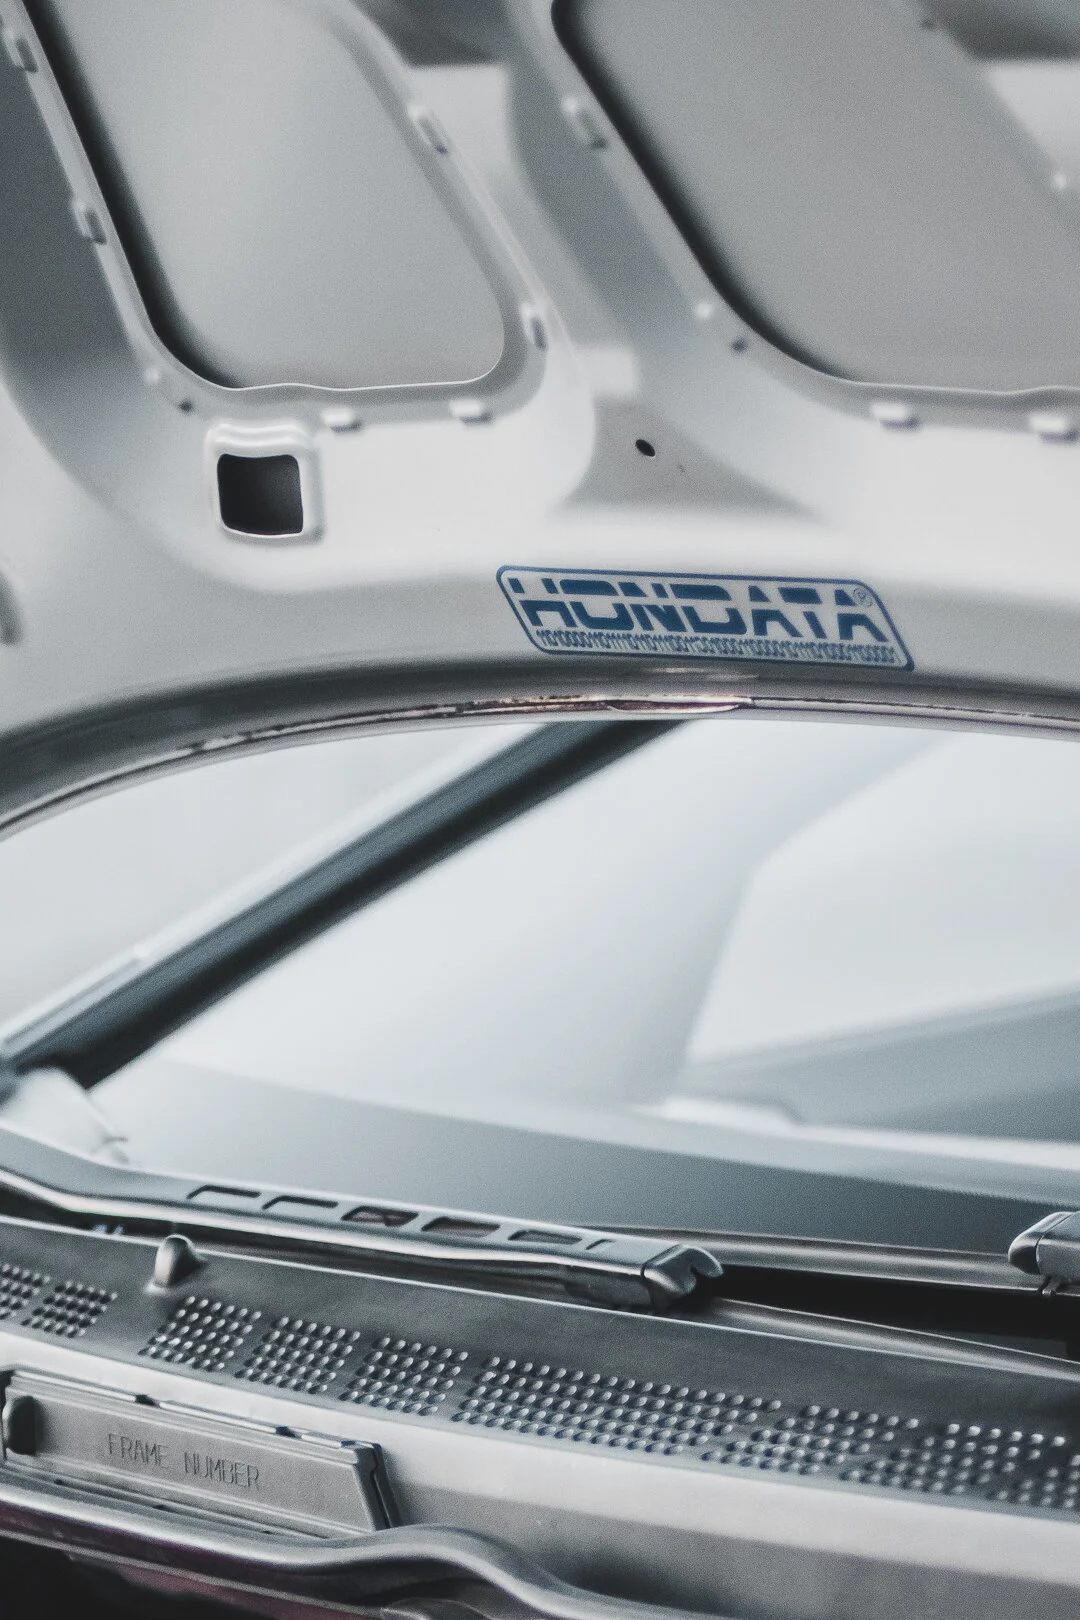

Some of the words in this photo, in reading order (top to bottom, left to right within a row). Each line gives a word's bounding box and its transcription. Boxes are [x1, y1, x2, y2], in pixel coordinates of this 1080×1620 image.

[508, 577, 889, 642] HONDATA
[107, 1433, 170, 1468] FRAME
[184, 1451, 261, 1490] NUMBER
